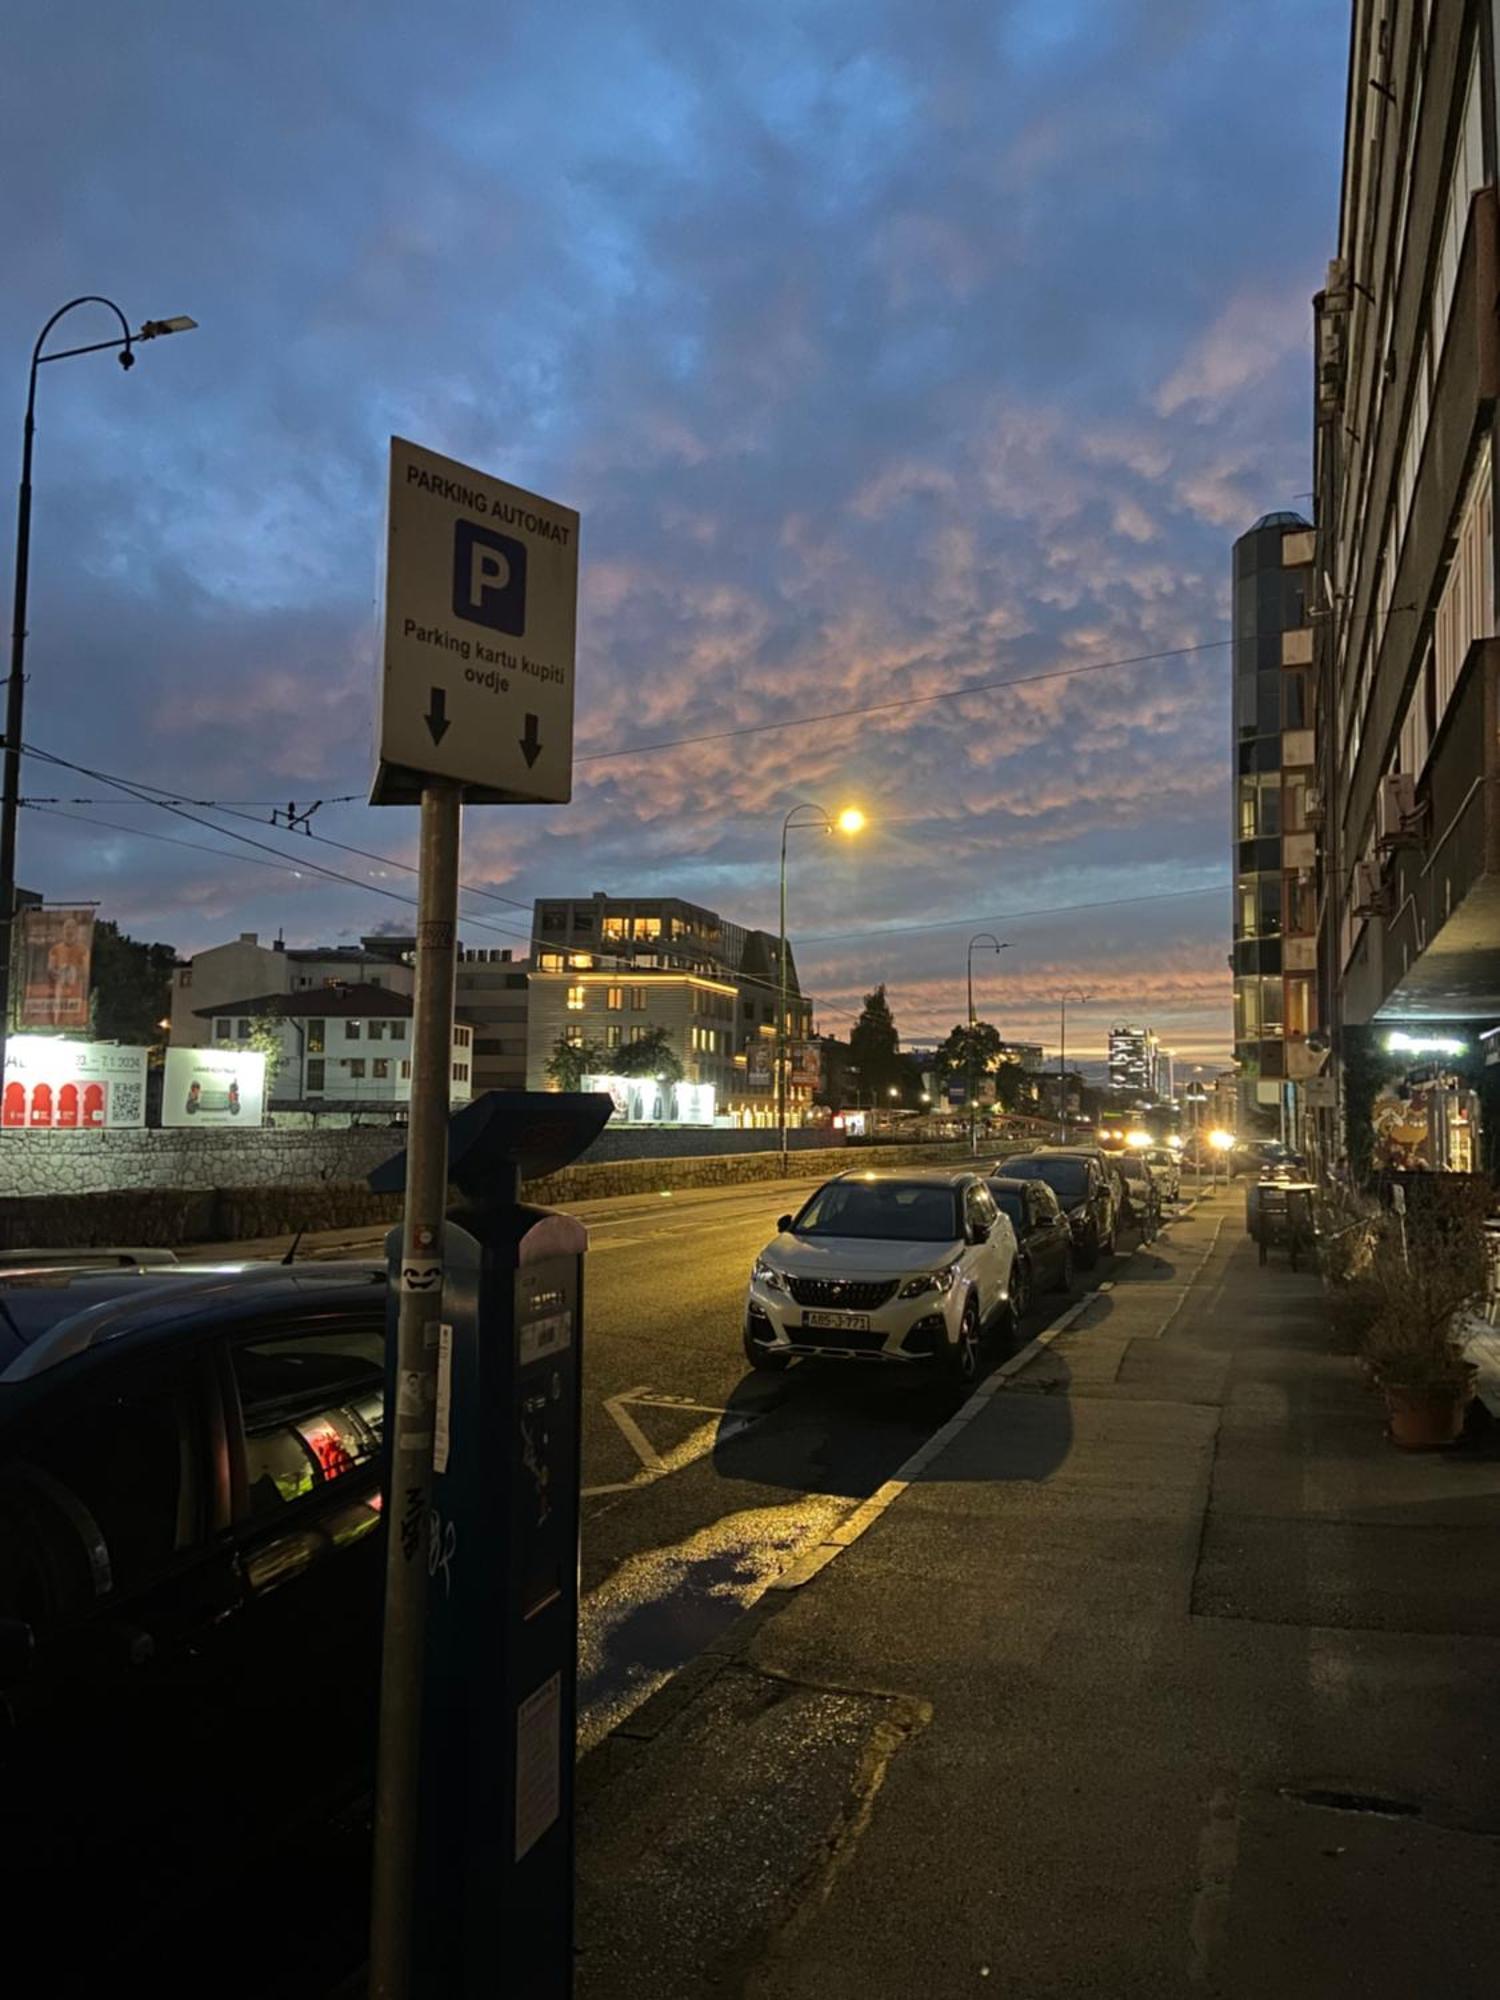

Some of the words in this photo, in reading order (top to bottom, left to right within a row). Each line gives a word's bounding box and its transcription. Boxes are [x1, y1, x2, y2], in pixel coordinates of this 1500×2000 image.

[406, 465, 487, 513] PARKING
[491, 504, 570, 544] AUTOMAT
[470, 541, 511, 607] P
[404, 619, 470, 659] Parking
[475, 641, 517, 669] kartu
[522, 652, 565, 685] kupiti
[464, 667, 510, 694] ovdje
